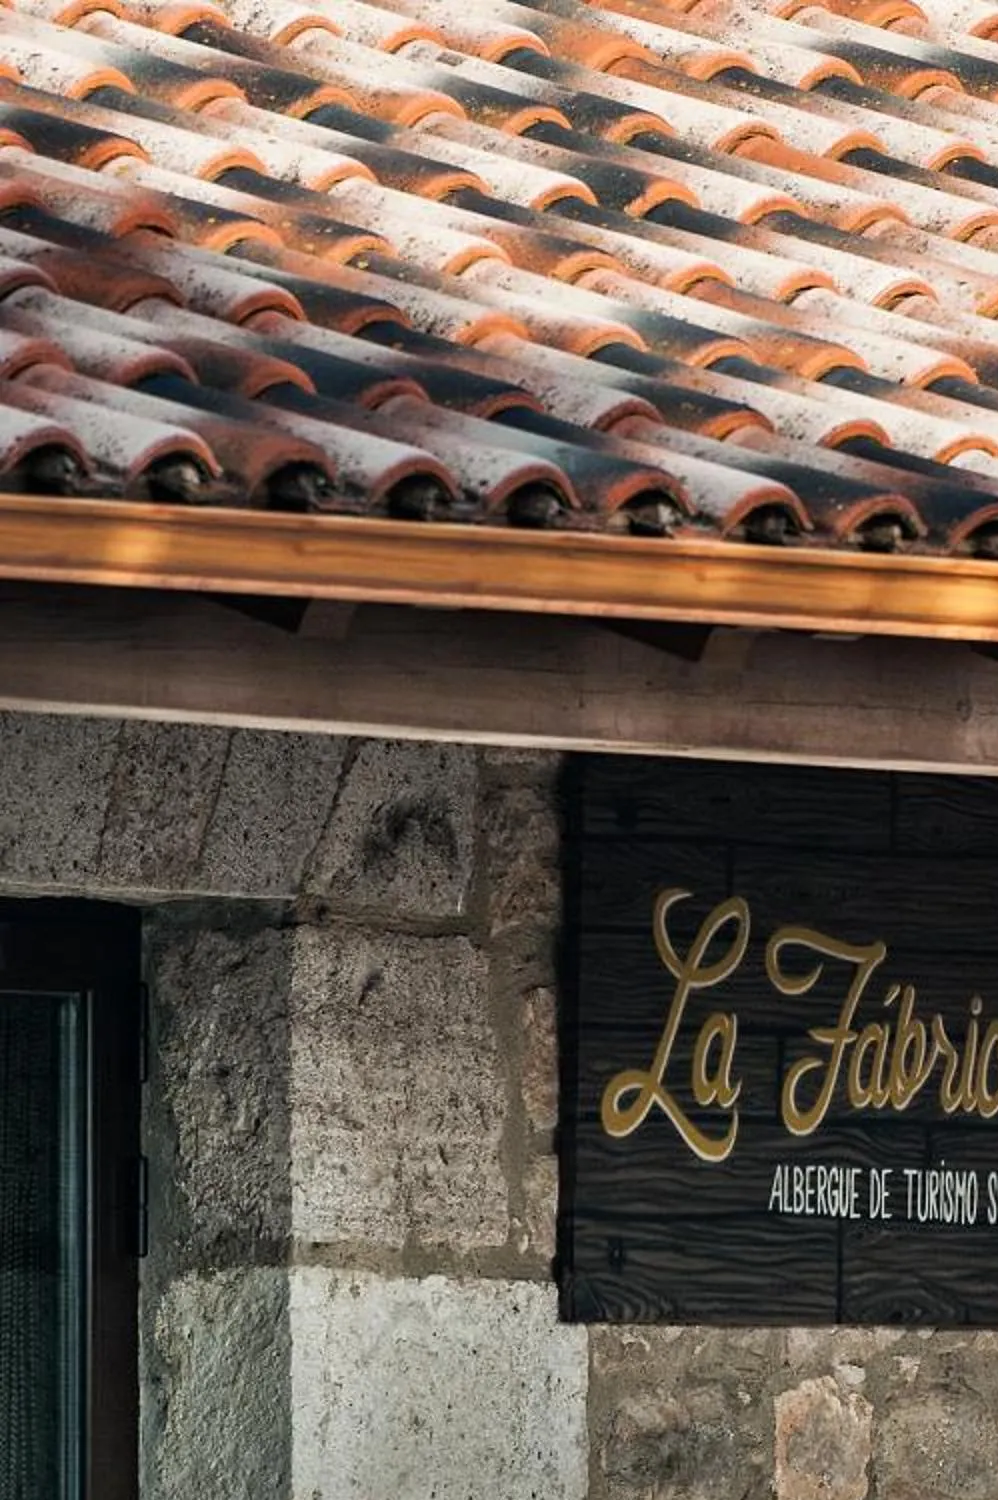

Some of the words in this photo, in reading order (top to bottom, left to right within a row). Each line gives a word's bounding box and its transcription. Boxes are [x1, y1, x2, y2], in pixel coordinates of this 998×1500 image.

[602, 887, 743, 1162] La
[768, 1164, 862, 1219] ALBERGUE
[869, 1167, 894, 1220] DE
